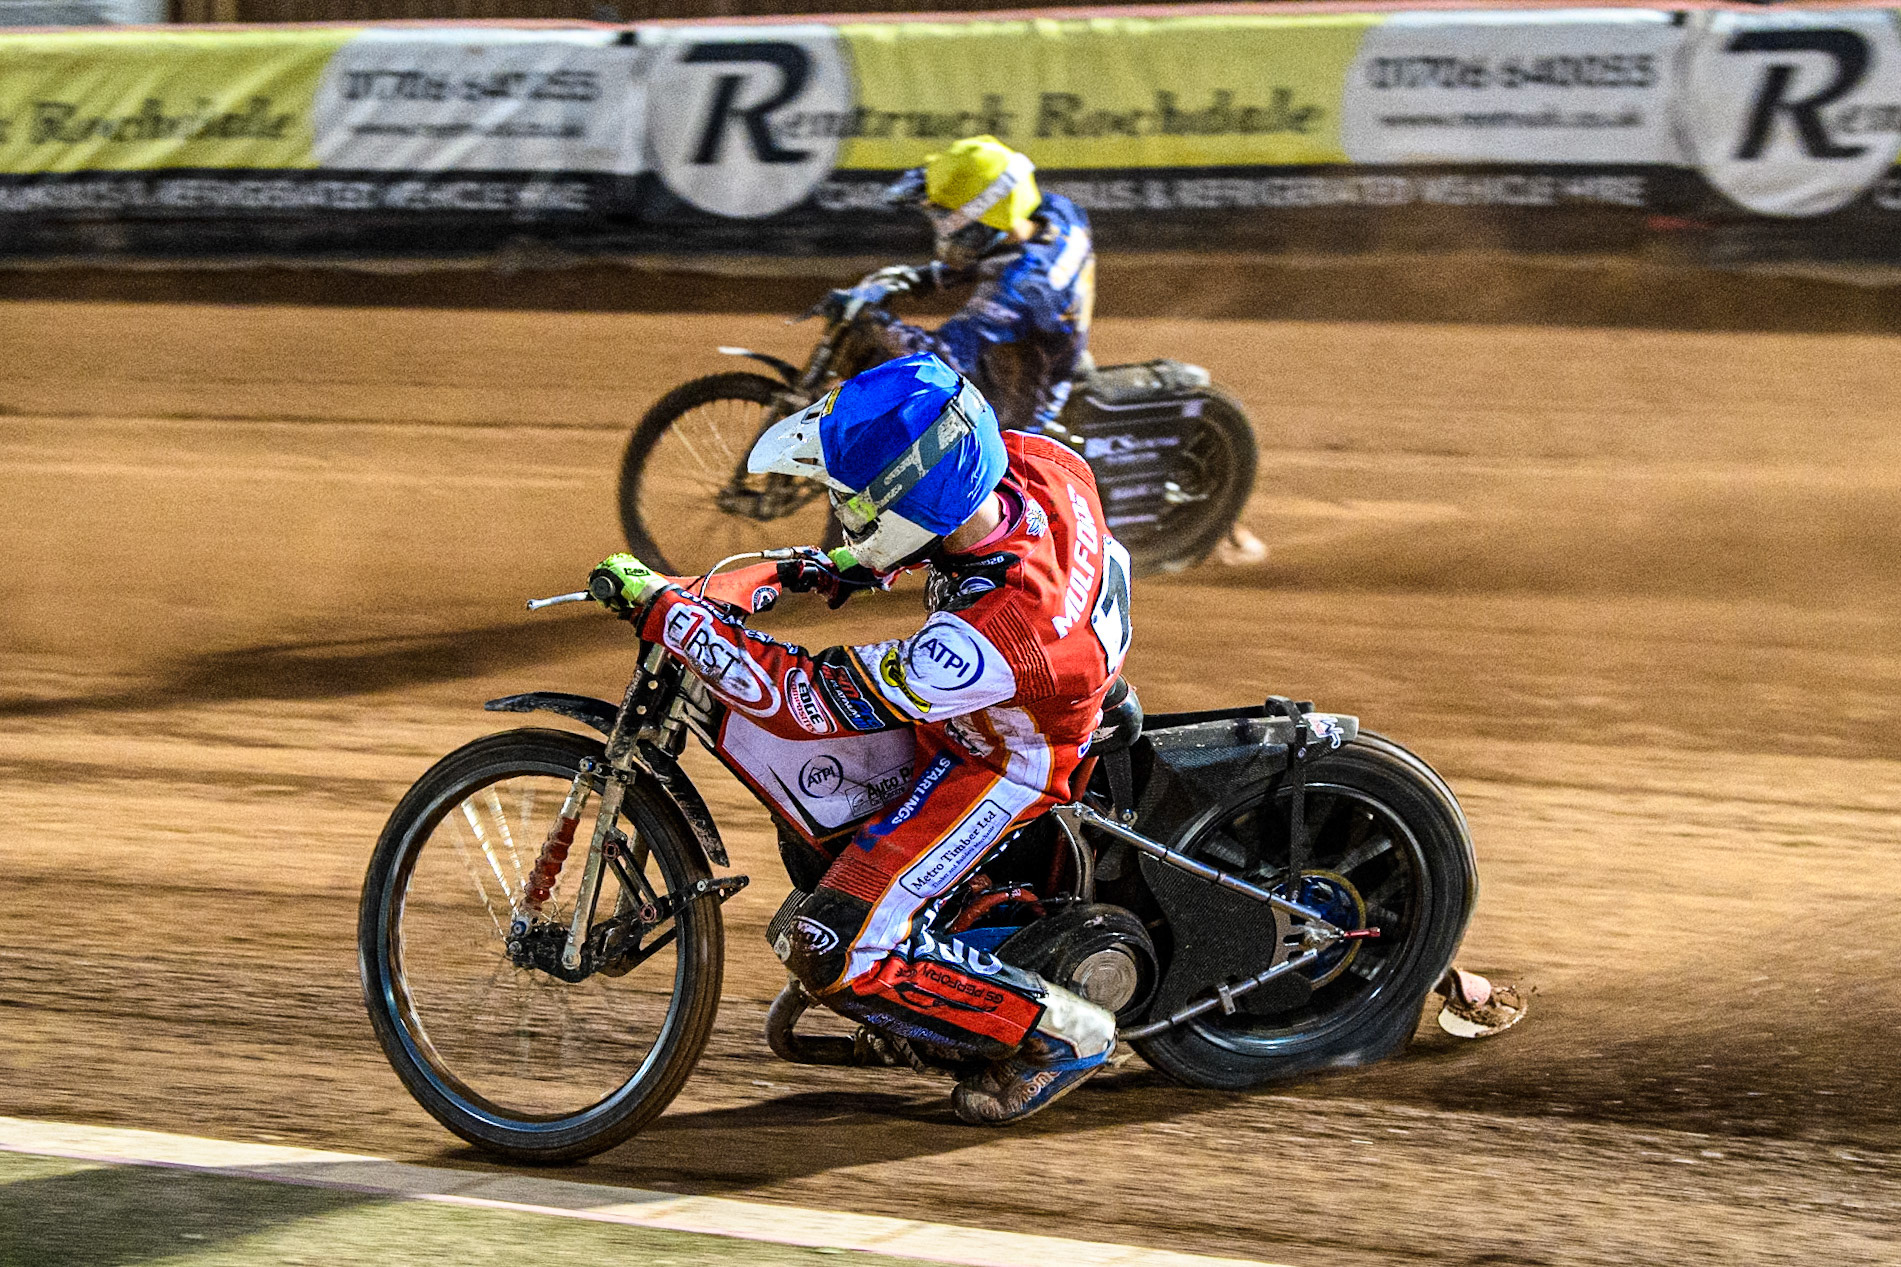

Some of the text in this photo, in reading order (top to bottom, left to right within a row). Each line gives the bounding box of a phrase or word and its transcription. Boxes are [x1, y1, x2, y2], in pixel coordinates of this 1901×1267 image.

[918, 637, 972, 679] ATPI
[799, 681, 824, 726] EDGE
[807, 765, 837, 788] ATPI
[891, 757, 951, 825] STARLINGS
[910, 810, 997, 891] Metro Timber Ltd
